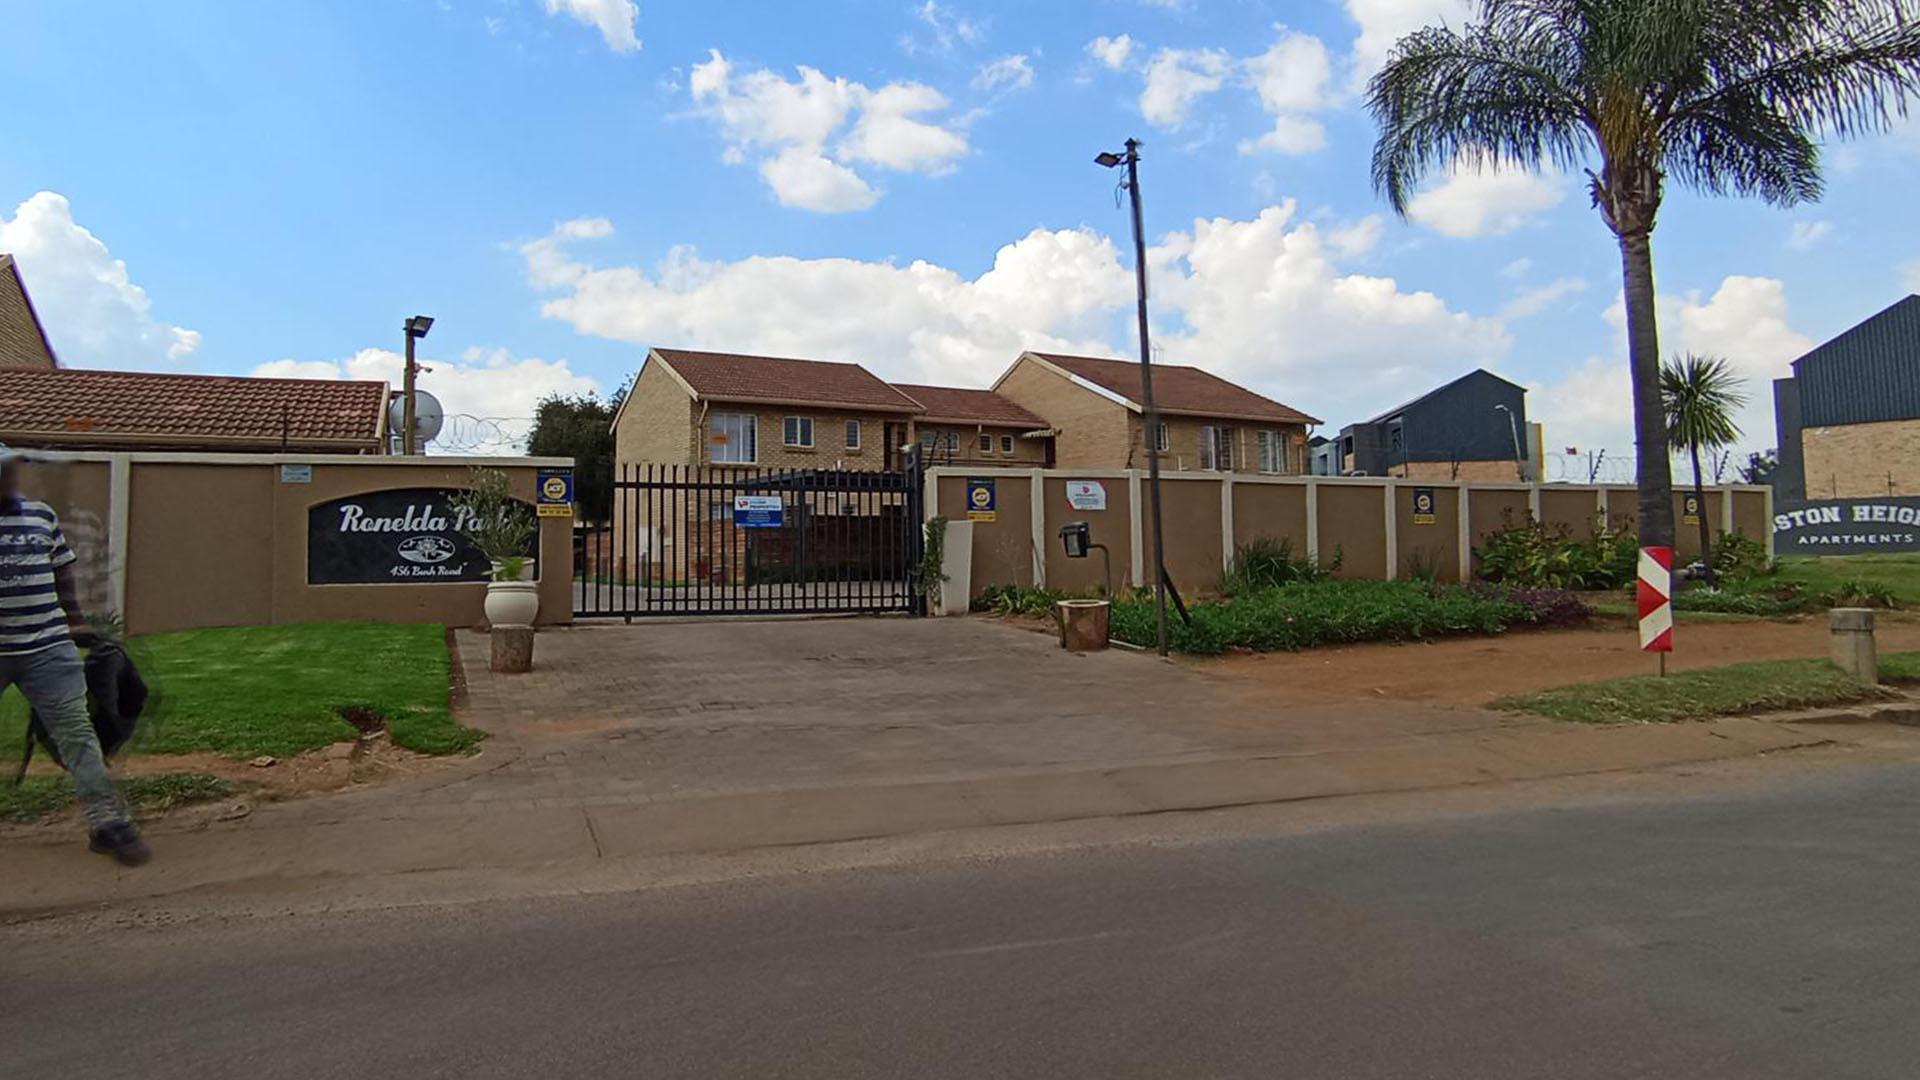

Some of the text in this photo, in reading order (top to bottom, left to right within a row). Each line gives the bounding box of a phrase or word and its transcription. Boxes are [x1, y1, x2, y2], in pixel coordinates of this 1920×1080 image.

[340, 504, 513, 532] Ronelda Pak
[1799, 534, 1913, 544] APARTMENTS
[390, 565, 410, 576] 456
[438, 565, 462, 576] Road
